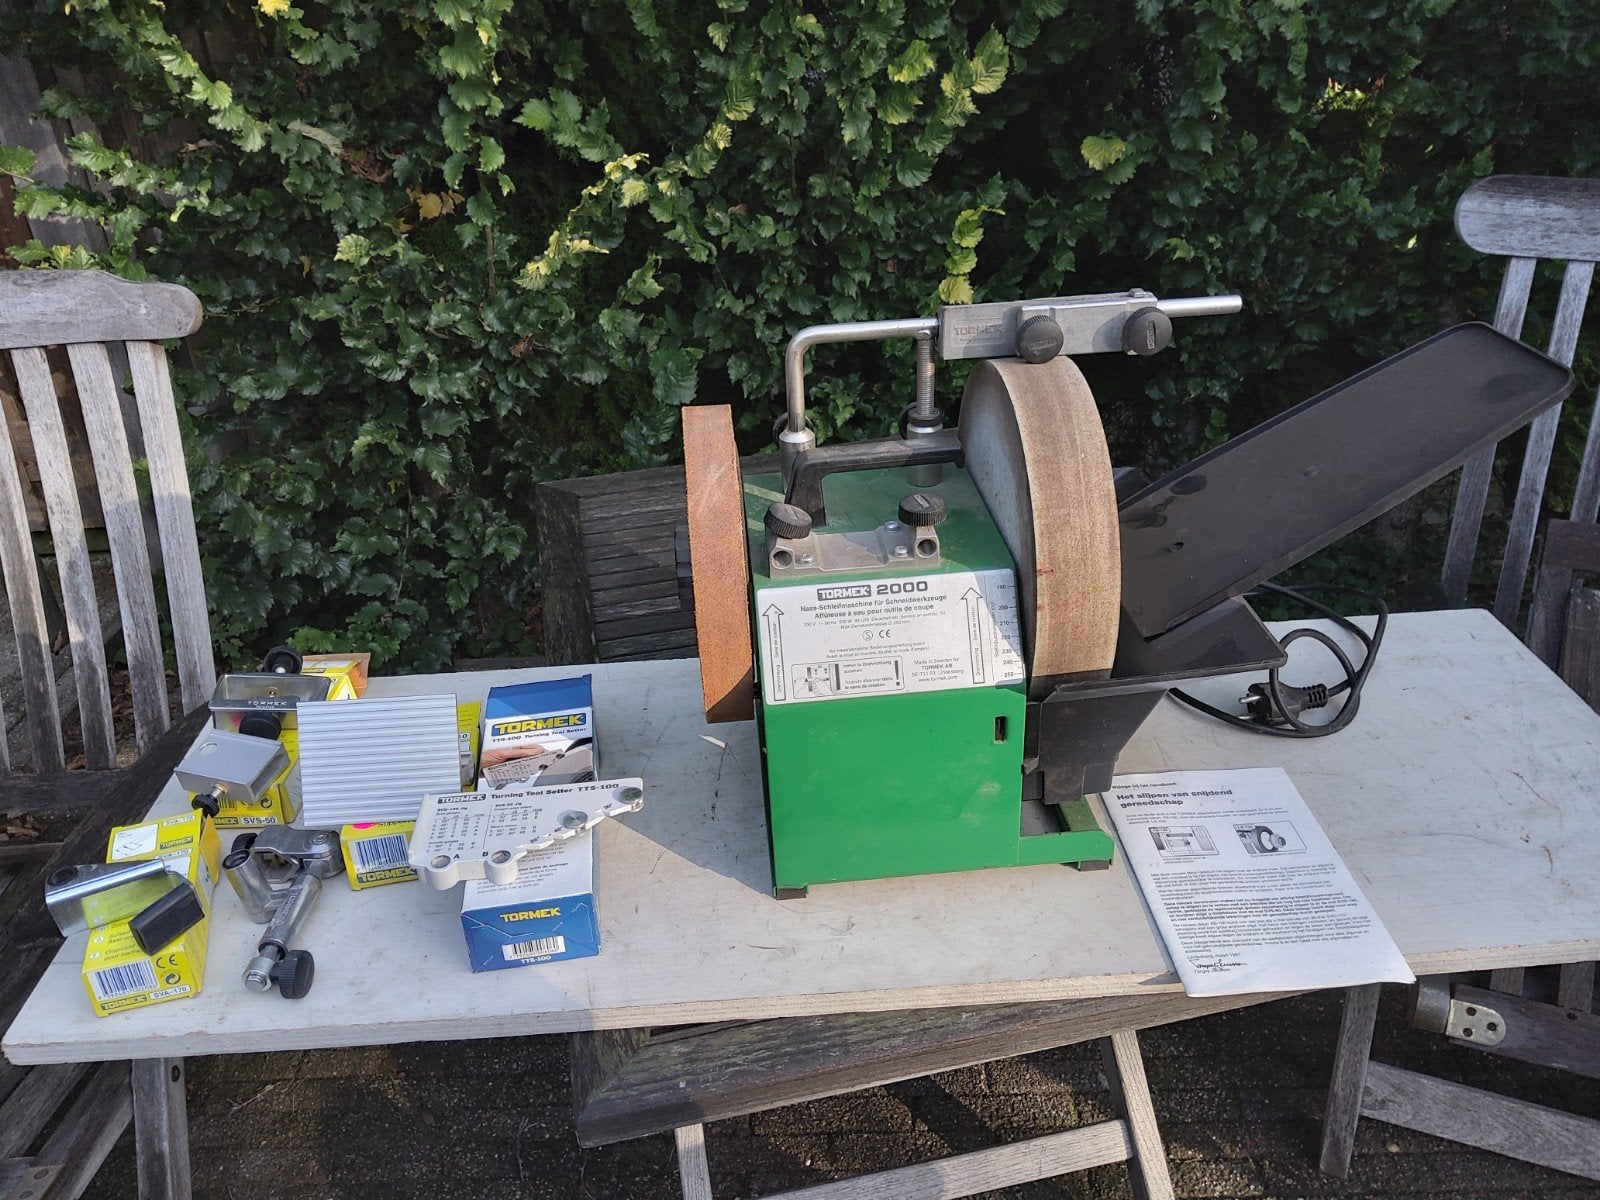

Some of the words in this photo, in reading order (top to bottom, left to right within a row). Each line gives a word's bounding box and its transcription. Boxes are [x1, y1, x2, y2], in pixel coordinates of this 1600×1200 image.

[817, 585, 871, 601] TORMEK
[876, 581, 928, 595] 2000
[800, 601, 873, 612] Nass-Schleifmaschine
[885, 595, 947, 605] Schneidwerkzeuge
[867, 609, 882, 617] pour
[884, 606, 903, 614] outils
[913, 604, 934, 612] coupe
[493, 714, 584, 735] TORMEK
[438, 794, 486, 804] TORMEK
[491, 792, 524, 800] Turning
[577, 784, 619, 792] TTS-100
[1190, 789, 1233, 797] snijdend
[1120, 799, 1184, 809] gereedschap
[214, 817, 238, 825] RMEK
[243, 817, 276, 825] SVS-50
[499, 907, 562, 922] TORMEK
[520, 955, 552, 964] TTS-100
[102, 995, 147, 1010] TORMEK
[153, 987, 187, 999] SVA-170
